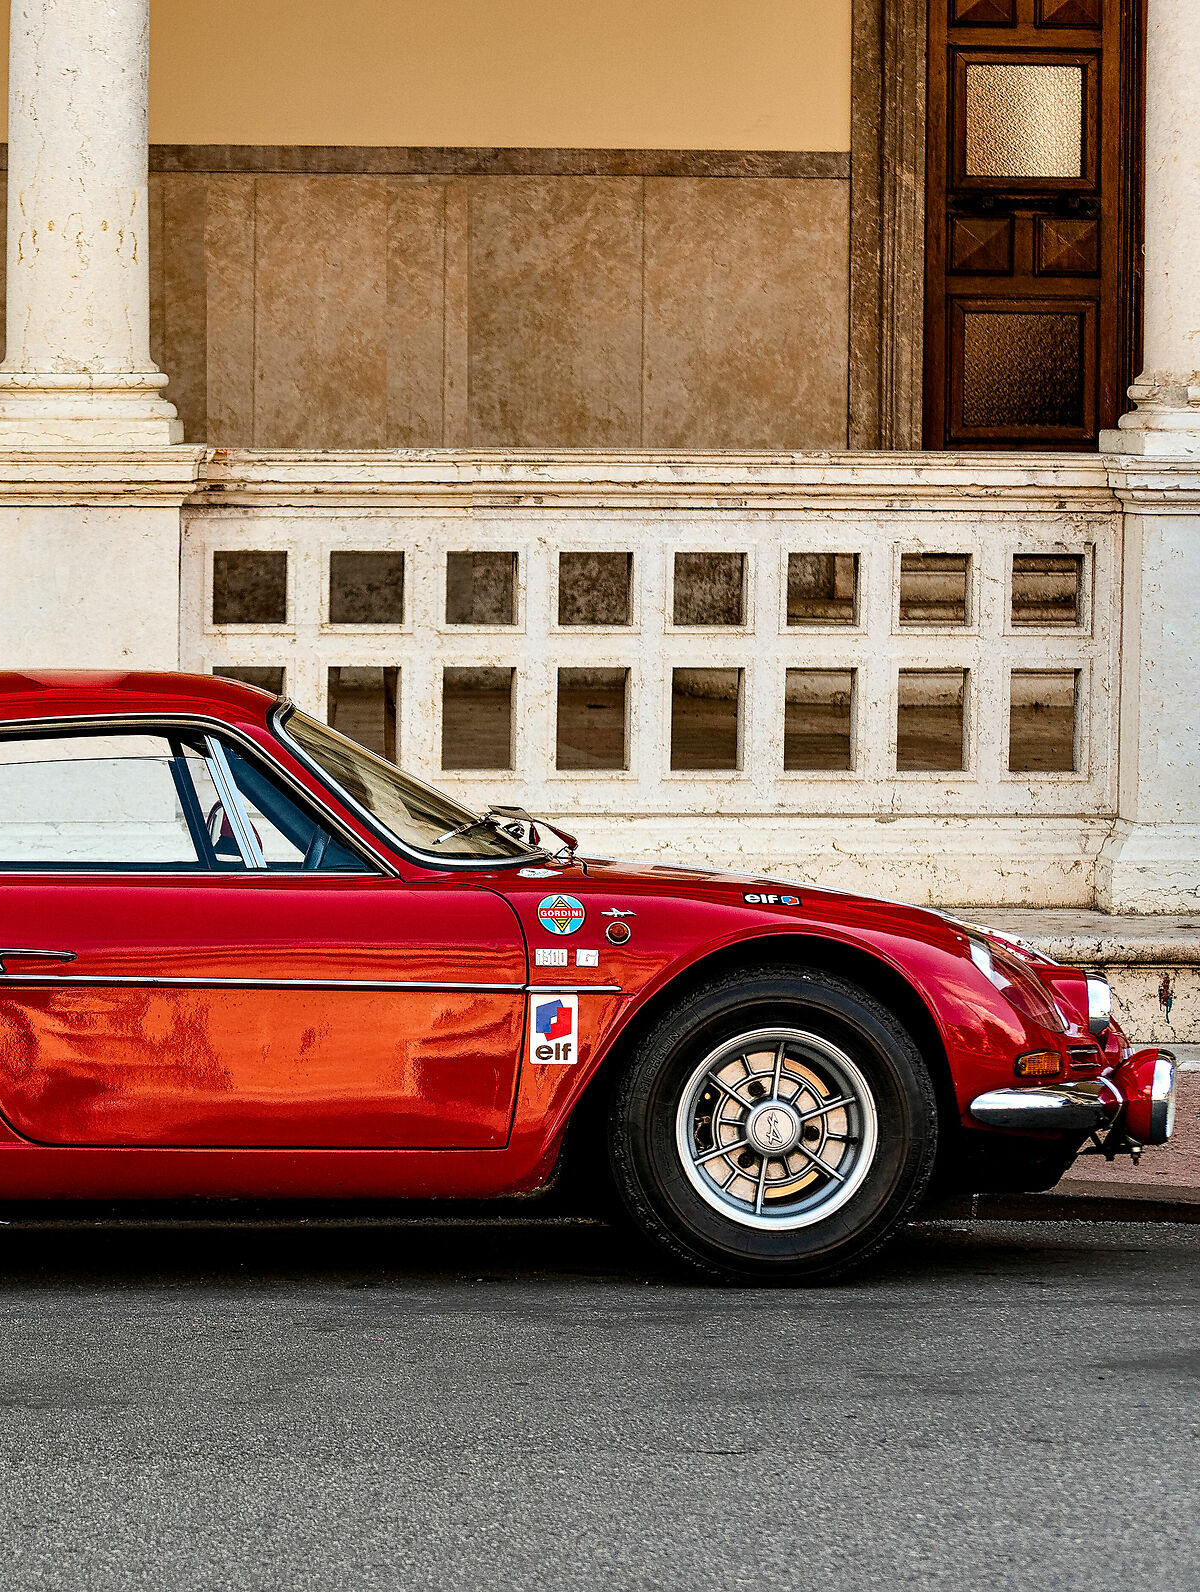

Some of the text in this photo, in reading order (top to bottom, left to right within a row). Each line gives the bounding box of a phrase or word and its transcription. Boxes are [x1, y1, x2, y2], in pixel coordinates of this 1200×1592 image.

[744, 893, 779, 904] elf
[535, 1042, 572, 1061] elf
[640, 1031, 680, 1094] MICHELIN
